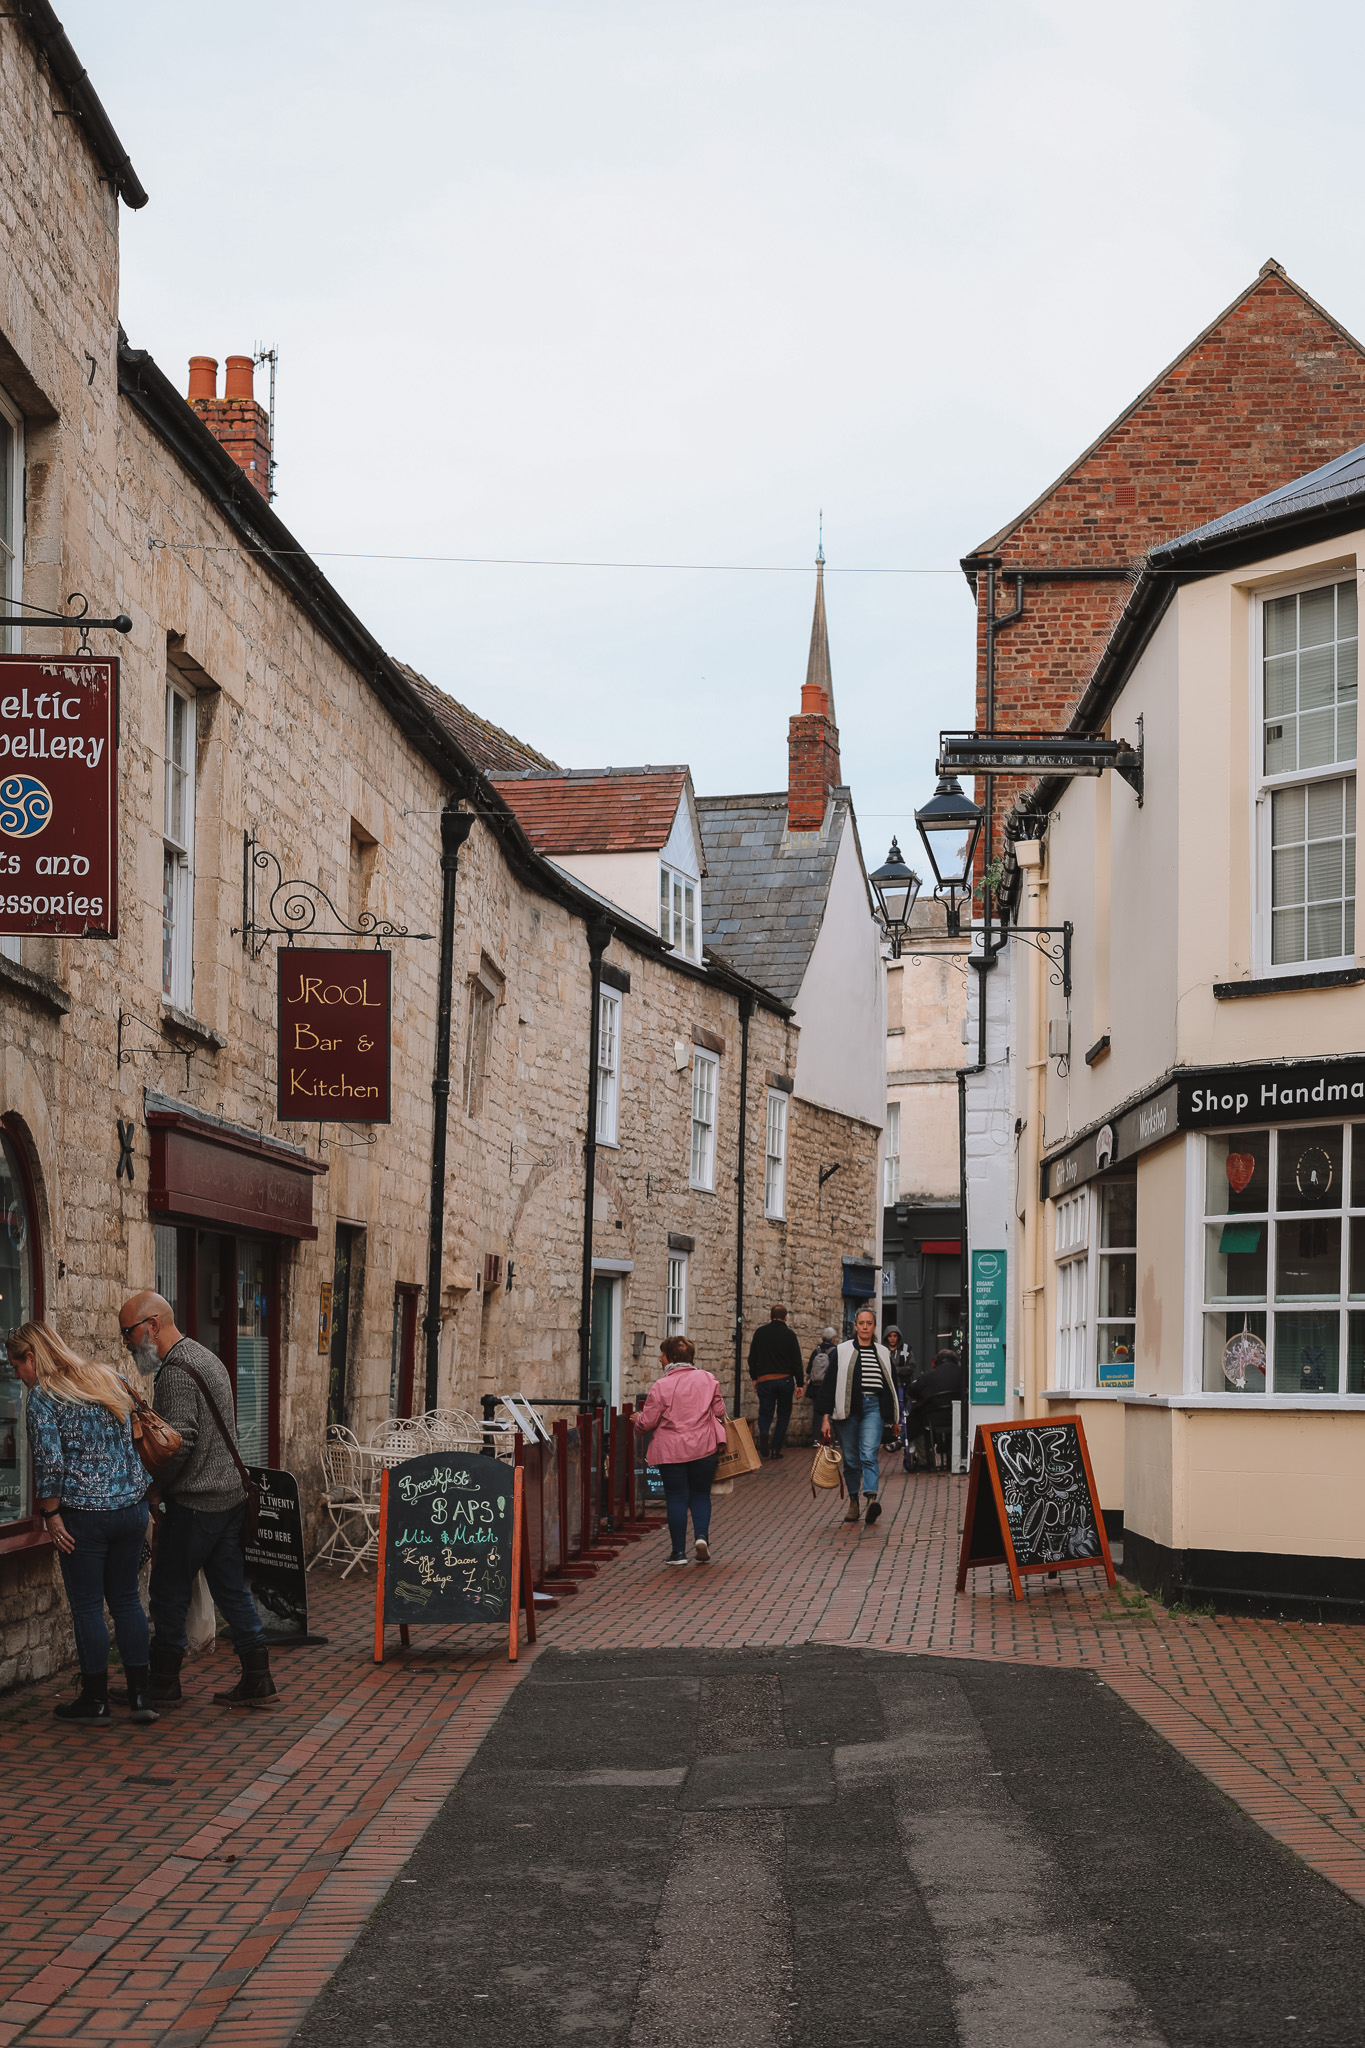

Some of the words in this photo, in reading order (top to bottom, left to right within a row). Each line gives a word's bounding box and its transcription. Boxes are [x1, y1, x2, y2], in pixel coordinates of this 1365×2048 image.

[0, 688, 81, 720] eltic
[35, 854, 90, 876] and
[0, 891, 103, 917] essories
[294, 1022, 343, 1051] Bar
[357, 1034, 374, 1052] &
[290, 1068, 379, 1098] Kitchen
[1191, 1089, 1249, 1114] Shop
[1260, 1078, 1365, 1107] Handma
[1139, 1102, 1167, 1140] Workshop
[1056, 1160, 1066, 1187] Gift
[1066, 1158, 1078, 1183] Shop
[398, 1467, 471, 1501] Breakfast
[267, 1497, 294, 1509] TWENTY
[274, 1530, 292, 1543] HERE
[395, 1528, 433, 1547] Mix
[450, 1525, 499, 1545] Match
[441, 1547, 479, 1567] Bacon
